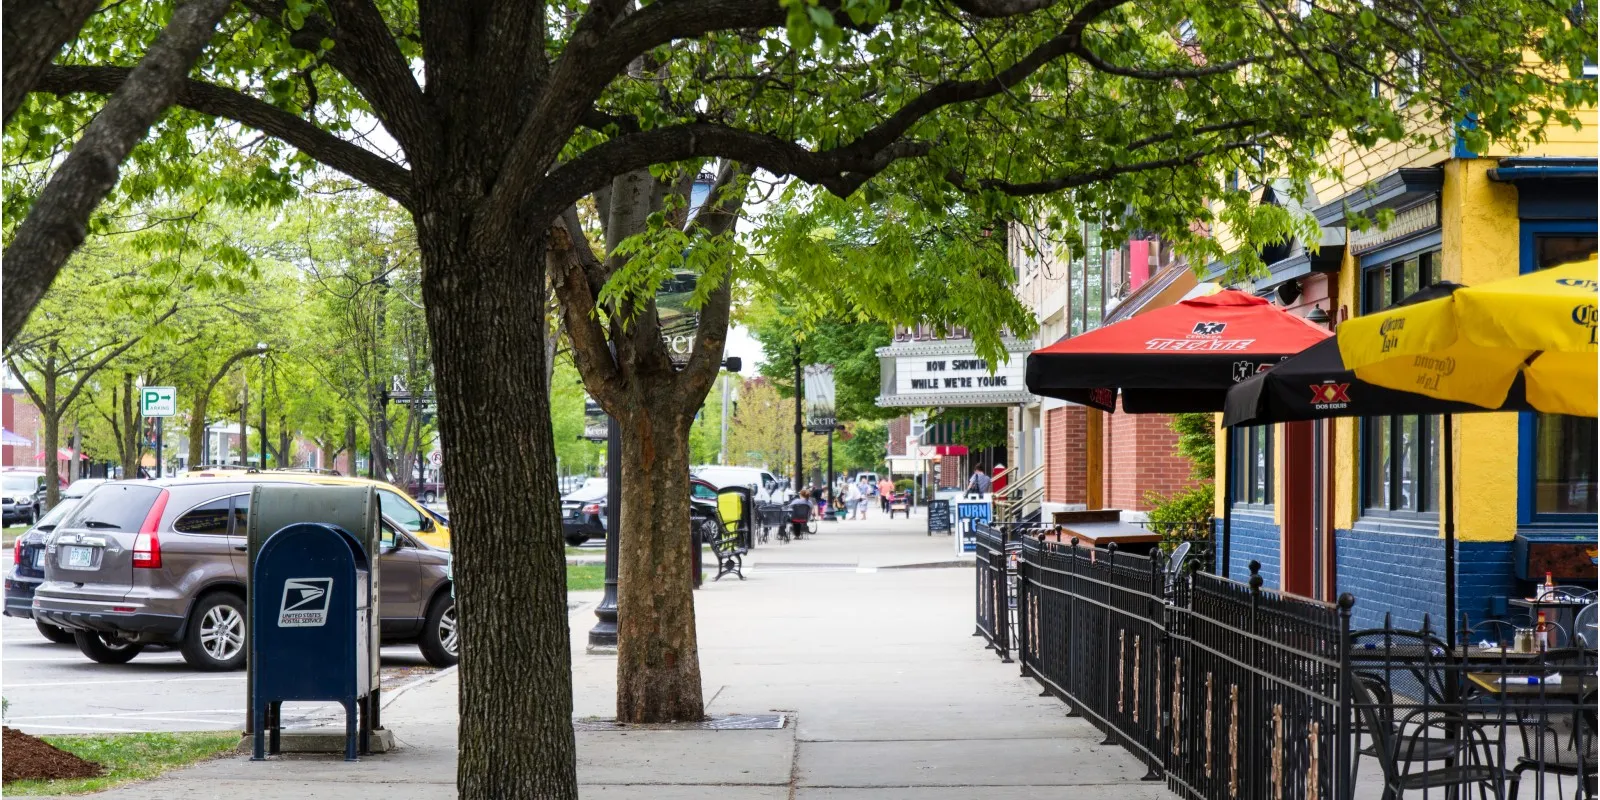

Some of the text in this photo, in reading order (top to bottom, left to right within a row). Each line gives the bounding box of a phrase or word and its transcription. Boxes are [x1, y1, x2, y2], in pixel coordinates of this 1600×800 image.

[1145, 339, 1256, 350] TECATE
[926, 359, 989, 371] NOW SHOWIN
[911, 376, 1007, 389] WHILE WE'RE YOUNG
[807, 415, 837, 425] Keene
[958, 504, 987, 518] TURN
